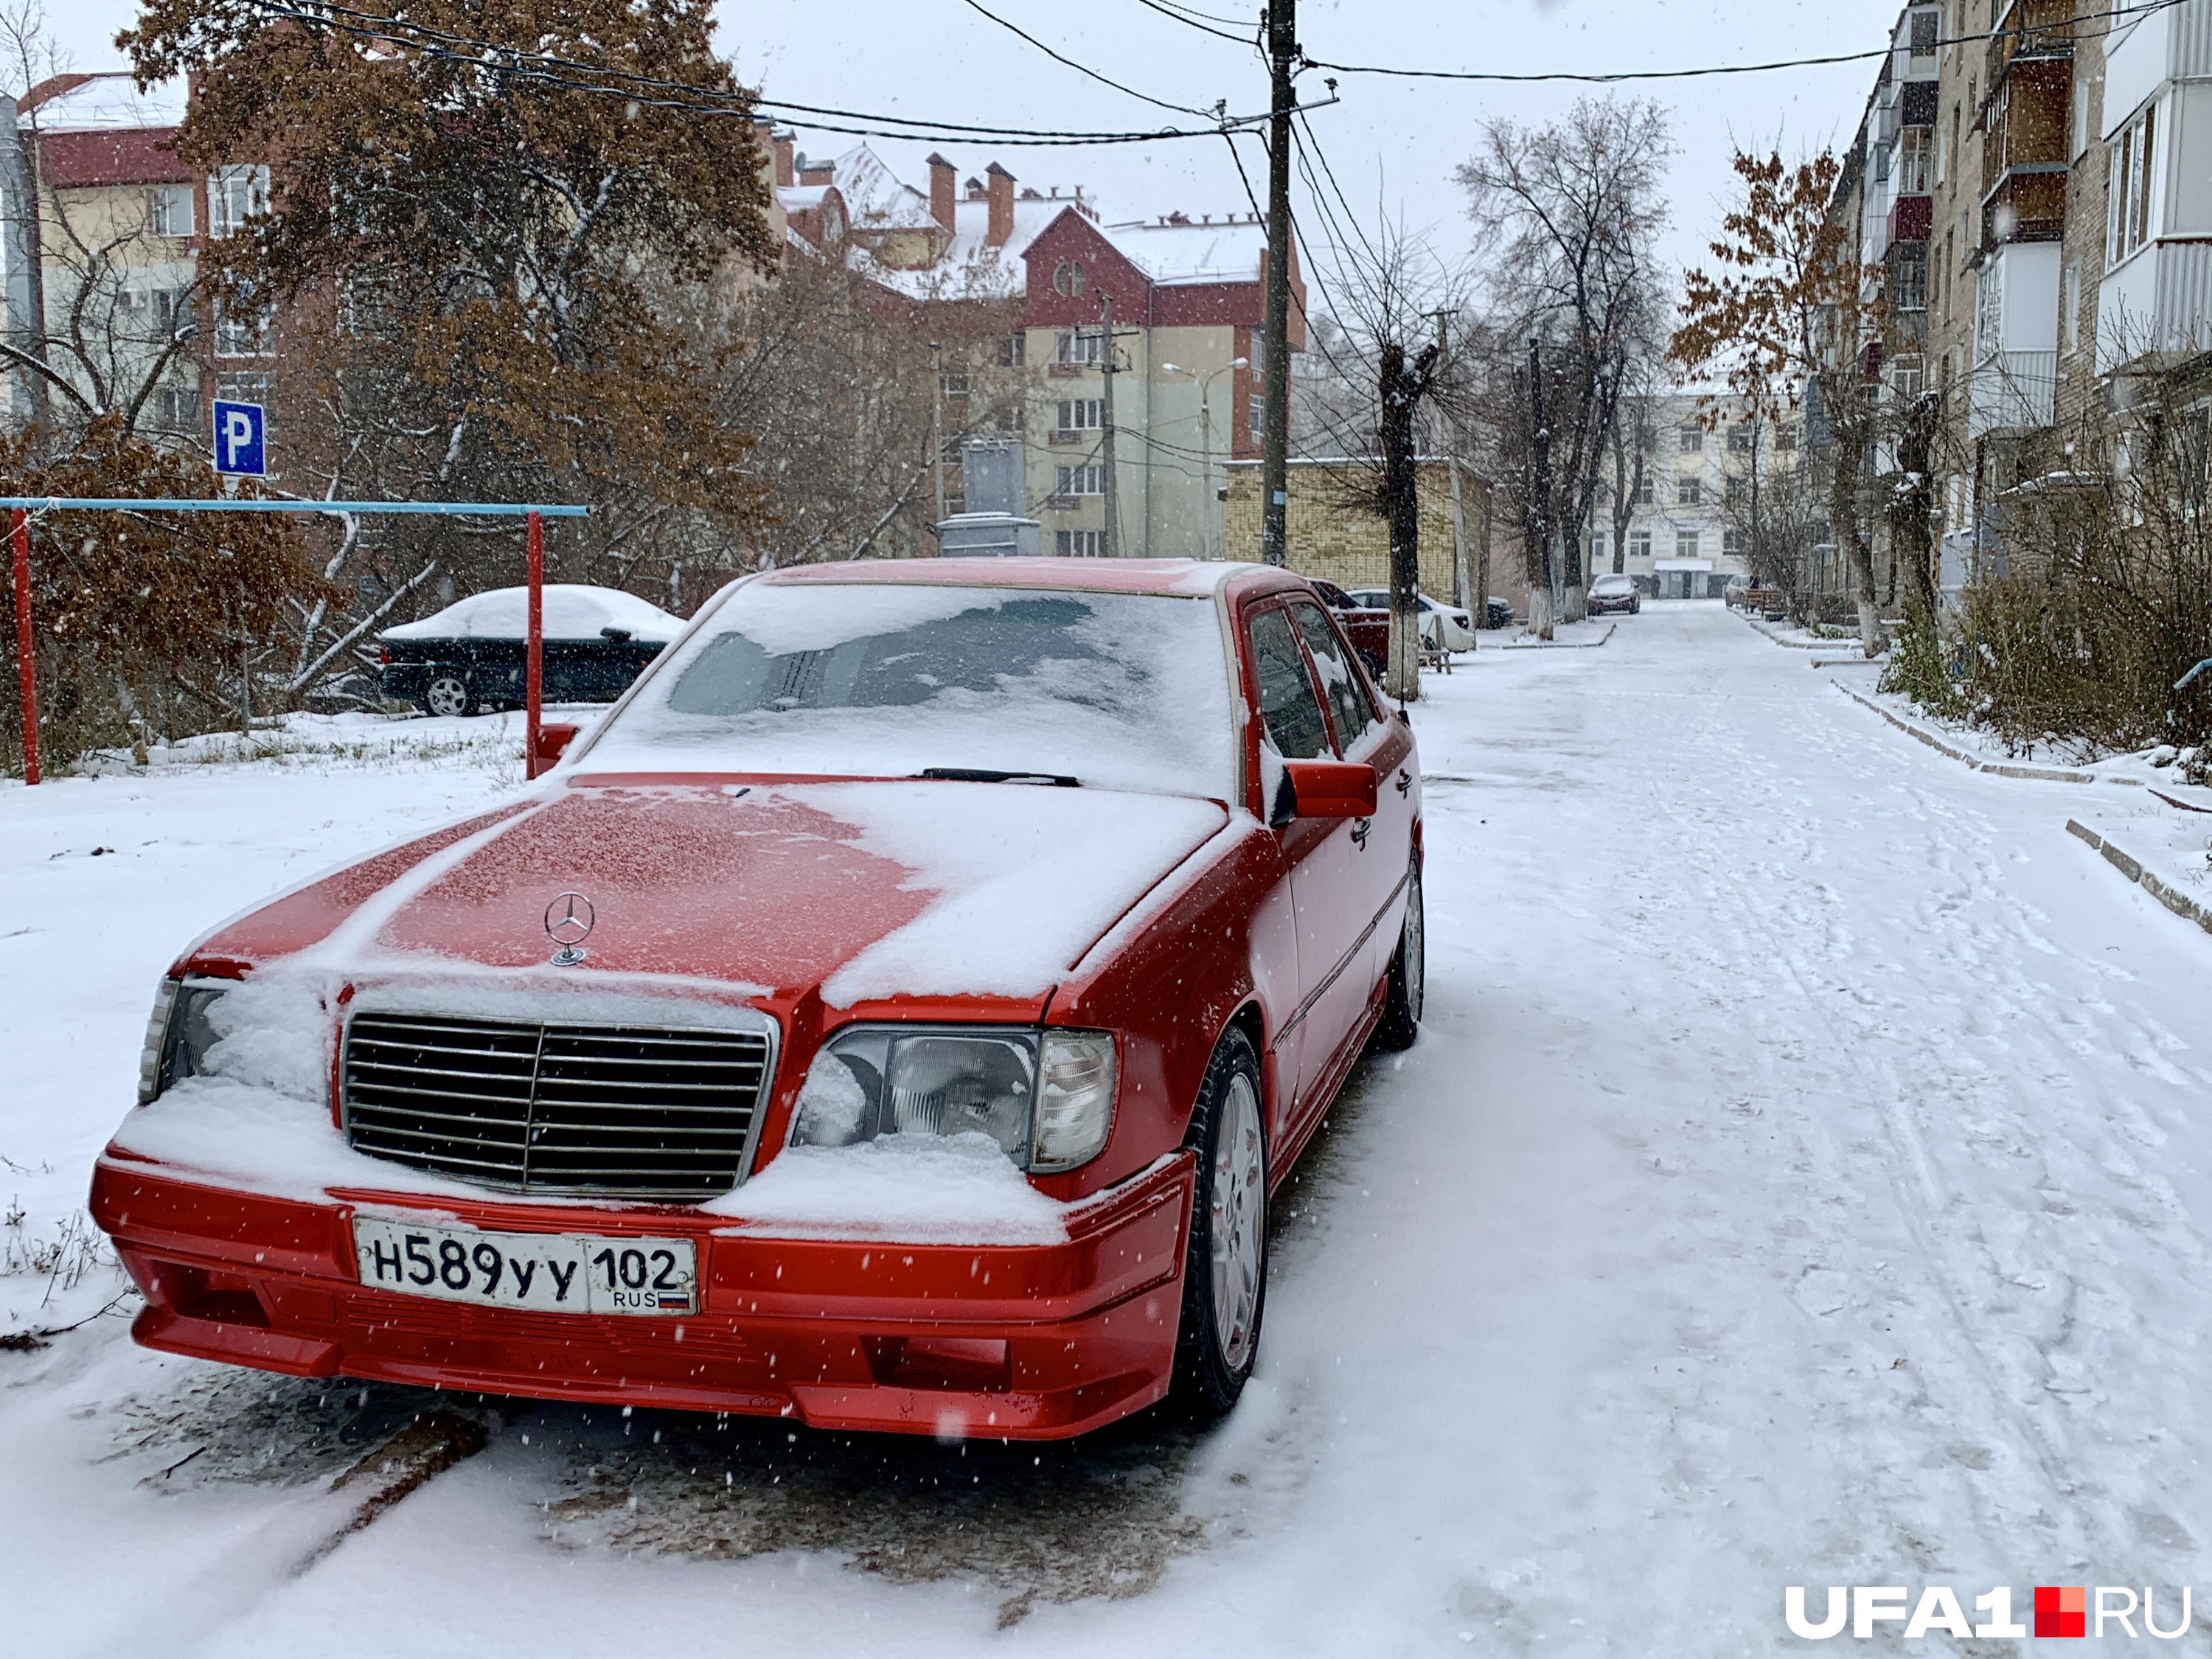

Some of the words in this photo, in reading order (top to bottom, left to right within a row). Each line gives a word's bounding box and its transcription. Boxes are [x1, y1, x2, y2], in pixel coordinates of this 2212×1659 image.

[226, 410, 252, 466] P
[373, 1234, 577, 1302] Н589УУ
[592, 1248, 678, 1290] 102
[613, 1291, 657, 1308] RUS
